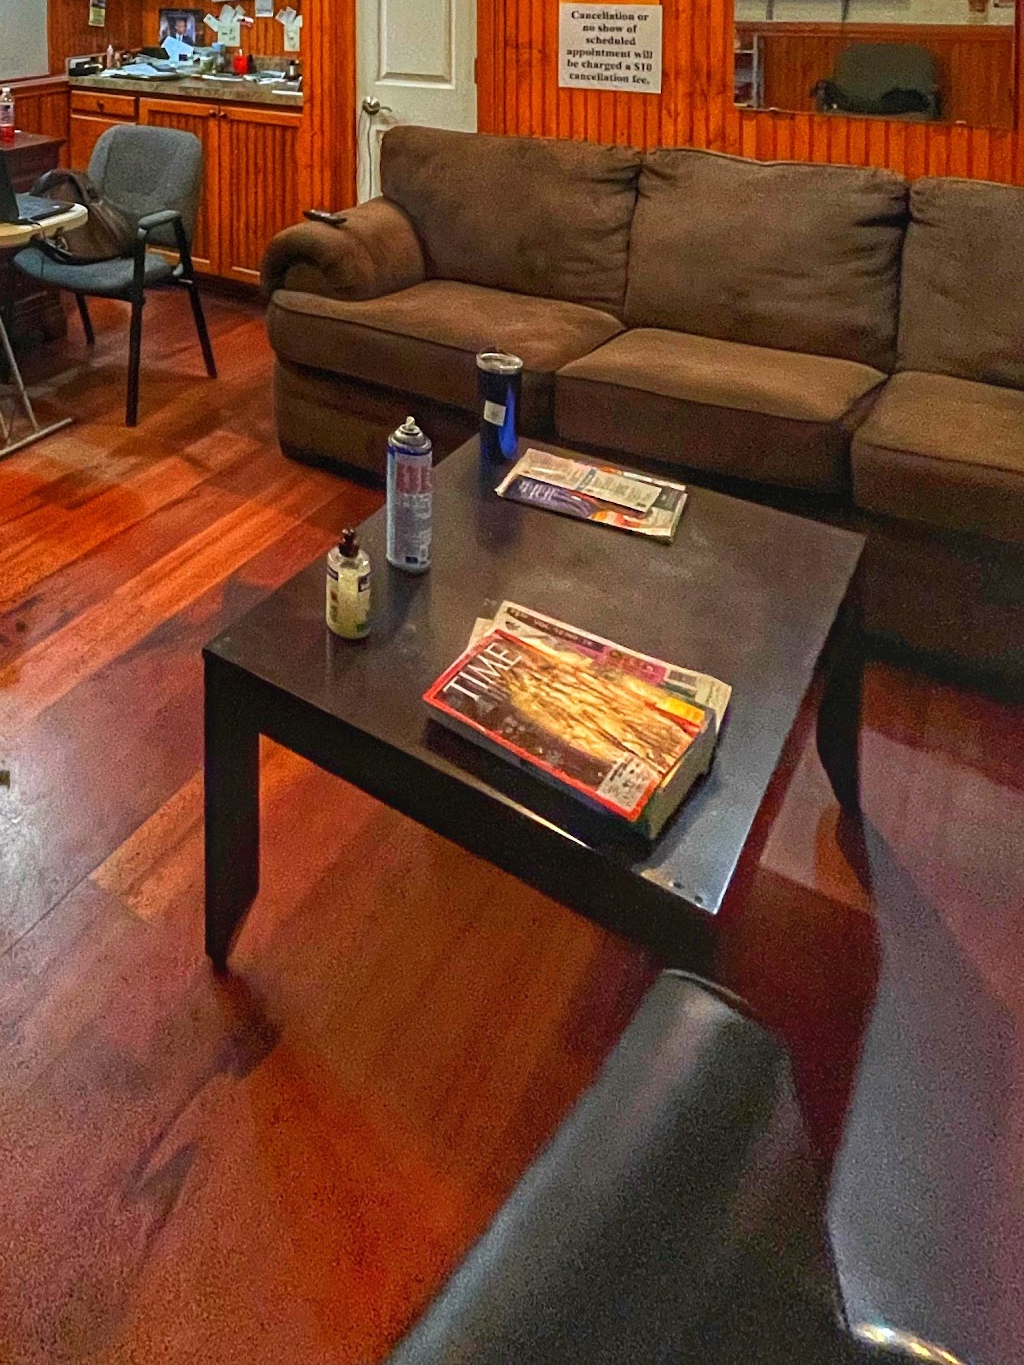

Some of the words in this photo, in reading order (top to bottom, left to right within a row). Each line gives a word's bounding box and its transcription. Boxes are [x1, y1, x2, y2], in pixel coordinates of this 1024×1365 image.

[571, 10, 635, 21] Cancellation
[597, 24, 623, 32] show
[626, 24, 637, 34] of
[585, 36, 636, 46] scheduled
[566, 48, 631, 59] appointment
[634, 50, 653, 59] will
[567, 59, 579, 68] be
[581, 60, 622, 71] charged
[569, 72, 629, 83] cancellation
[632, 75, 650, 85] fee.
[442, 642, 523, 702] TIME
